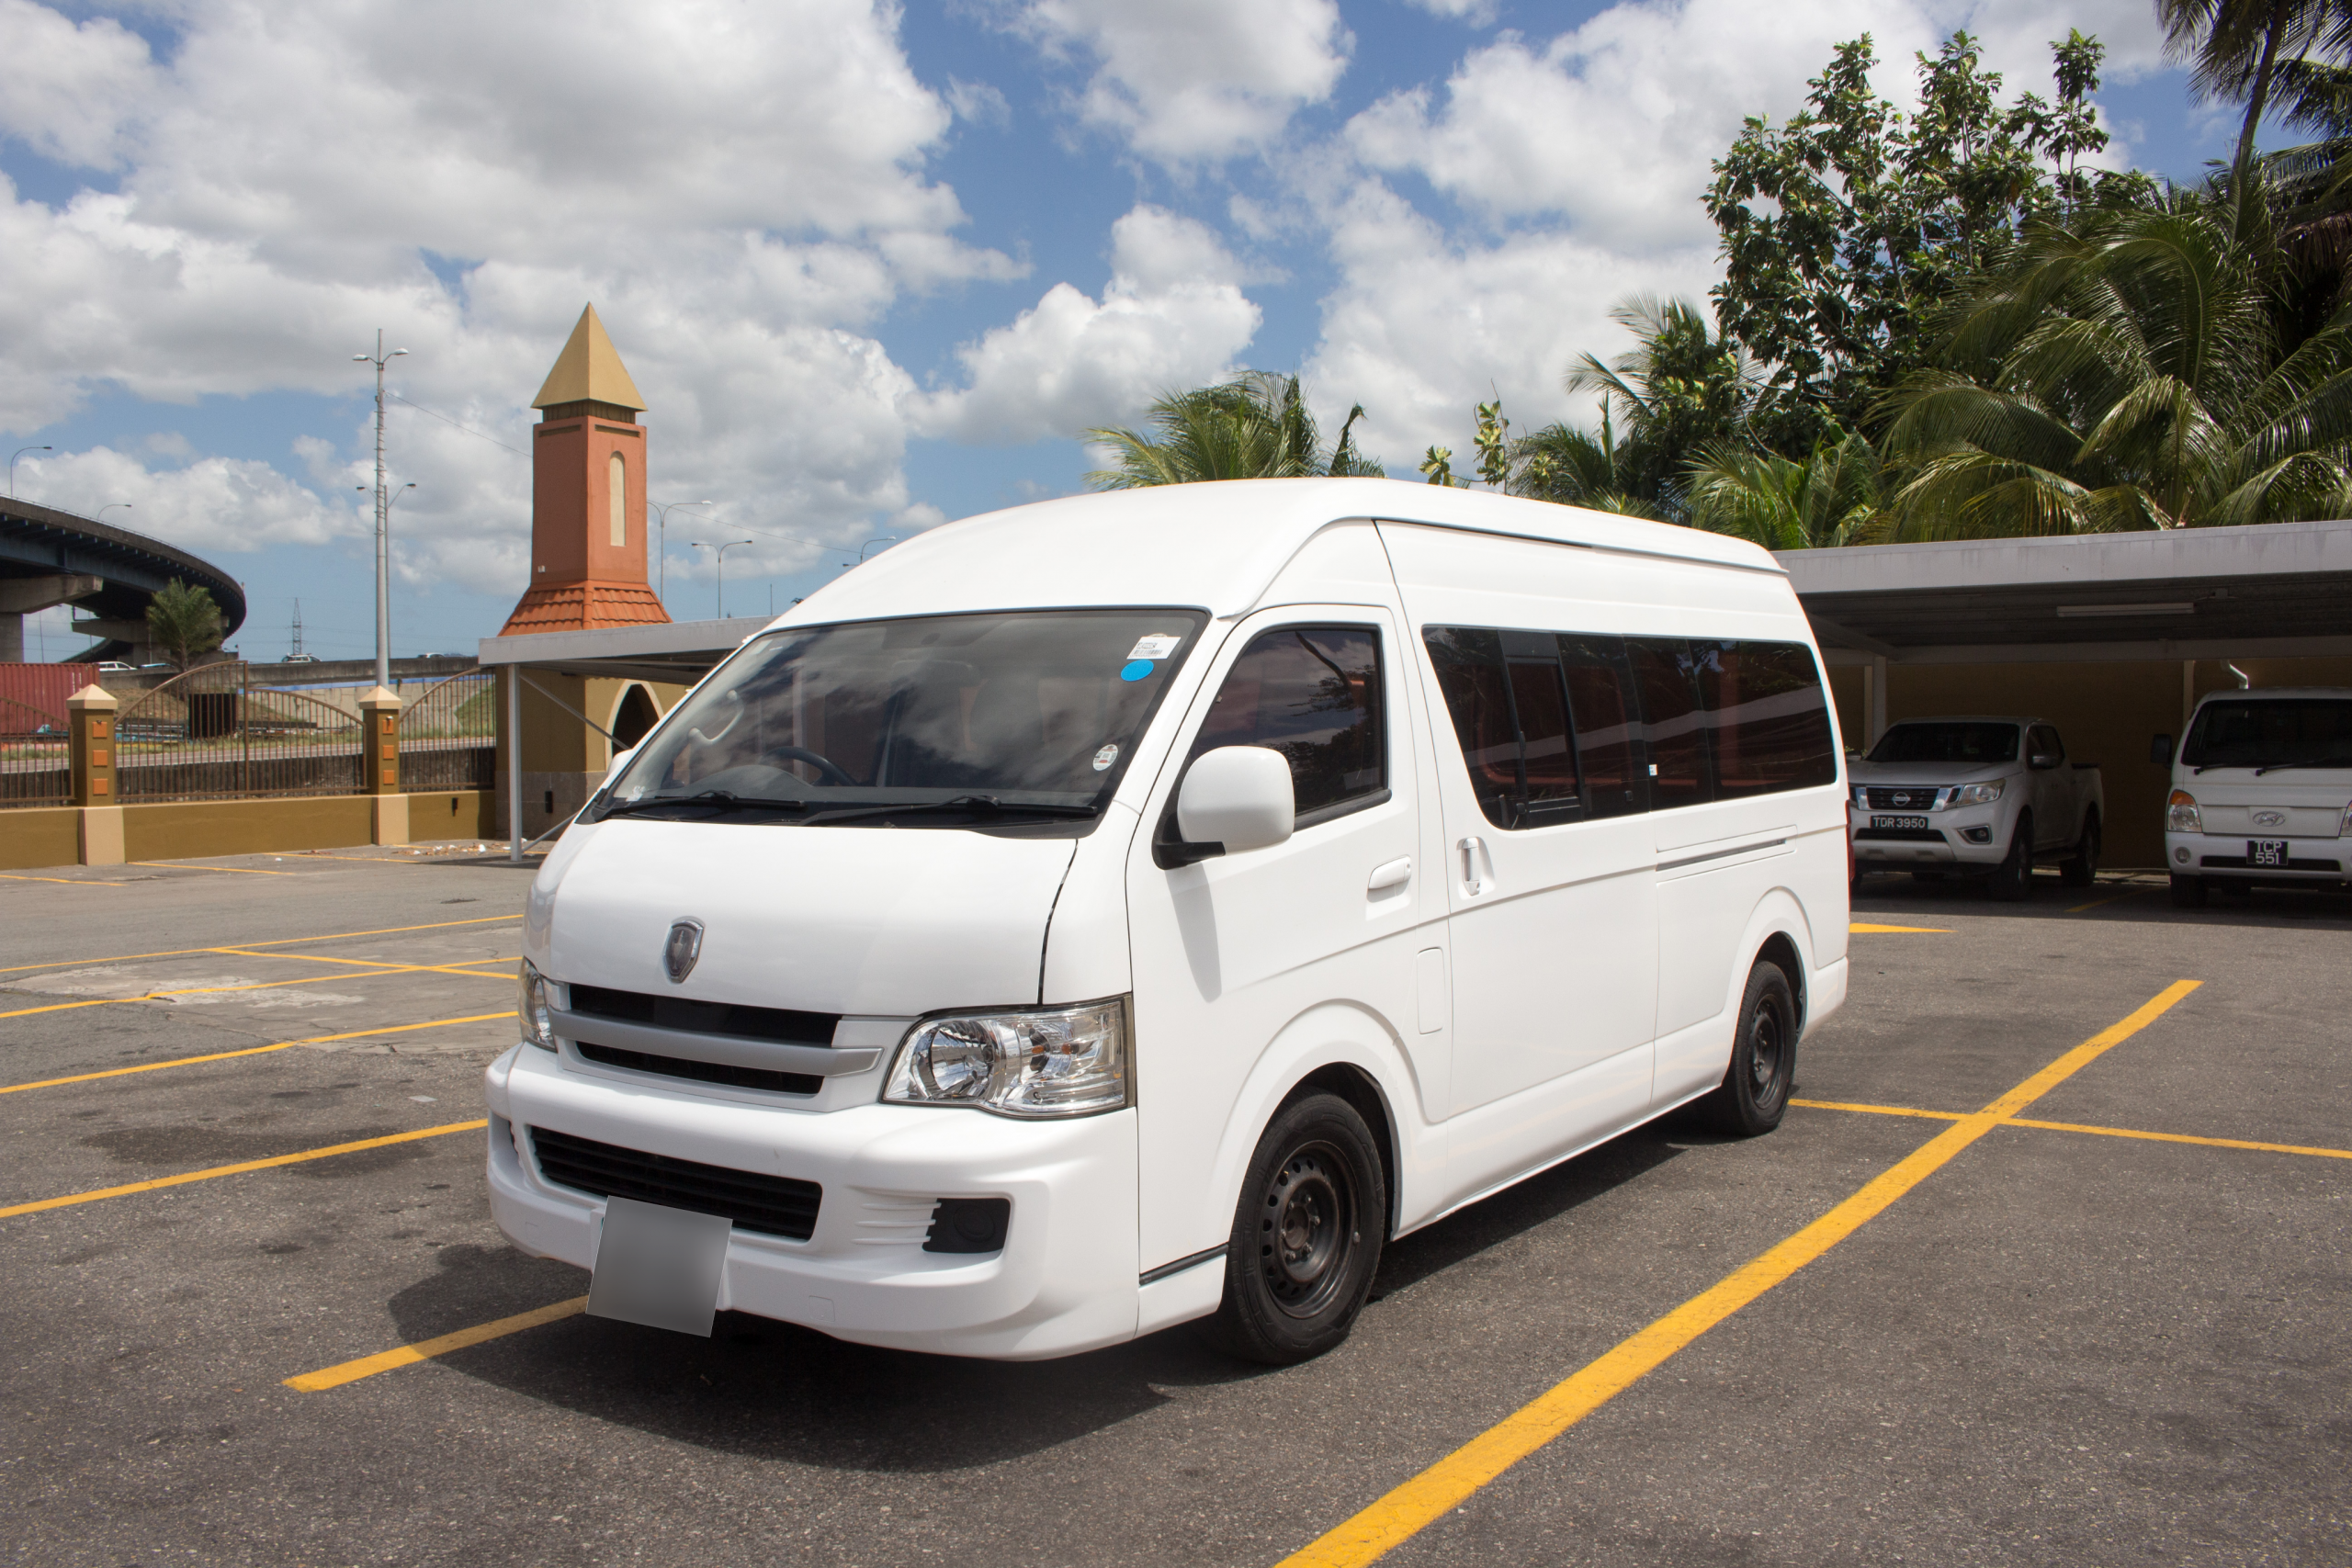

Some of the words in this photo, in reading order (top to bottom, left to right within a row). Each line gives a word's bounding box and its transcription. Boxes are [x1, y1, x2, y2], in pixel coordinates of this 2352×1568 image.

[1873, 817, 1894, 828] TDR
[1896, 818, 1926, 829] 3950
[2255, 840, 2282, 852] TCP
[2256, 852, 2279, 864] 551
